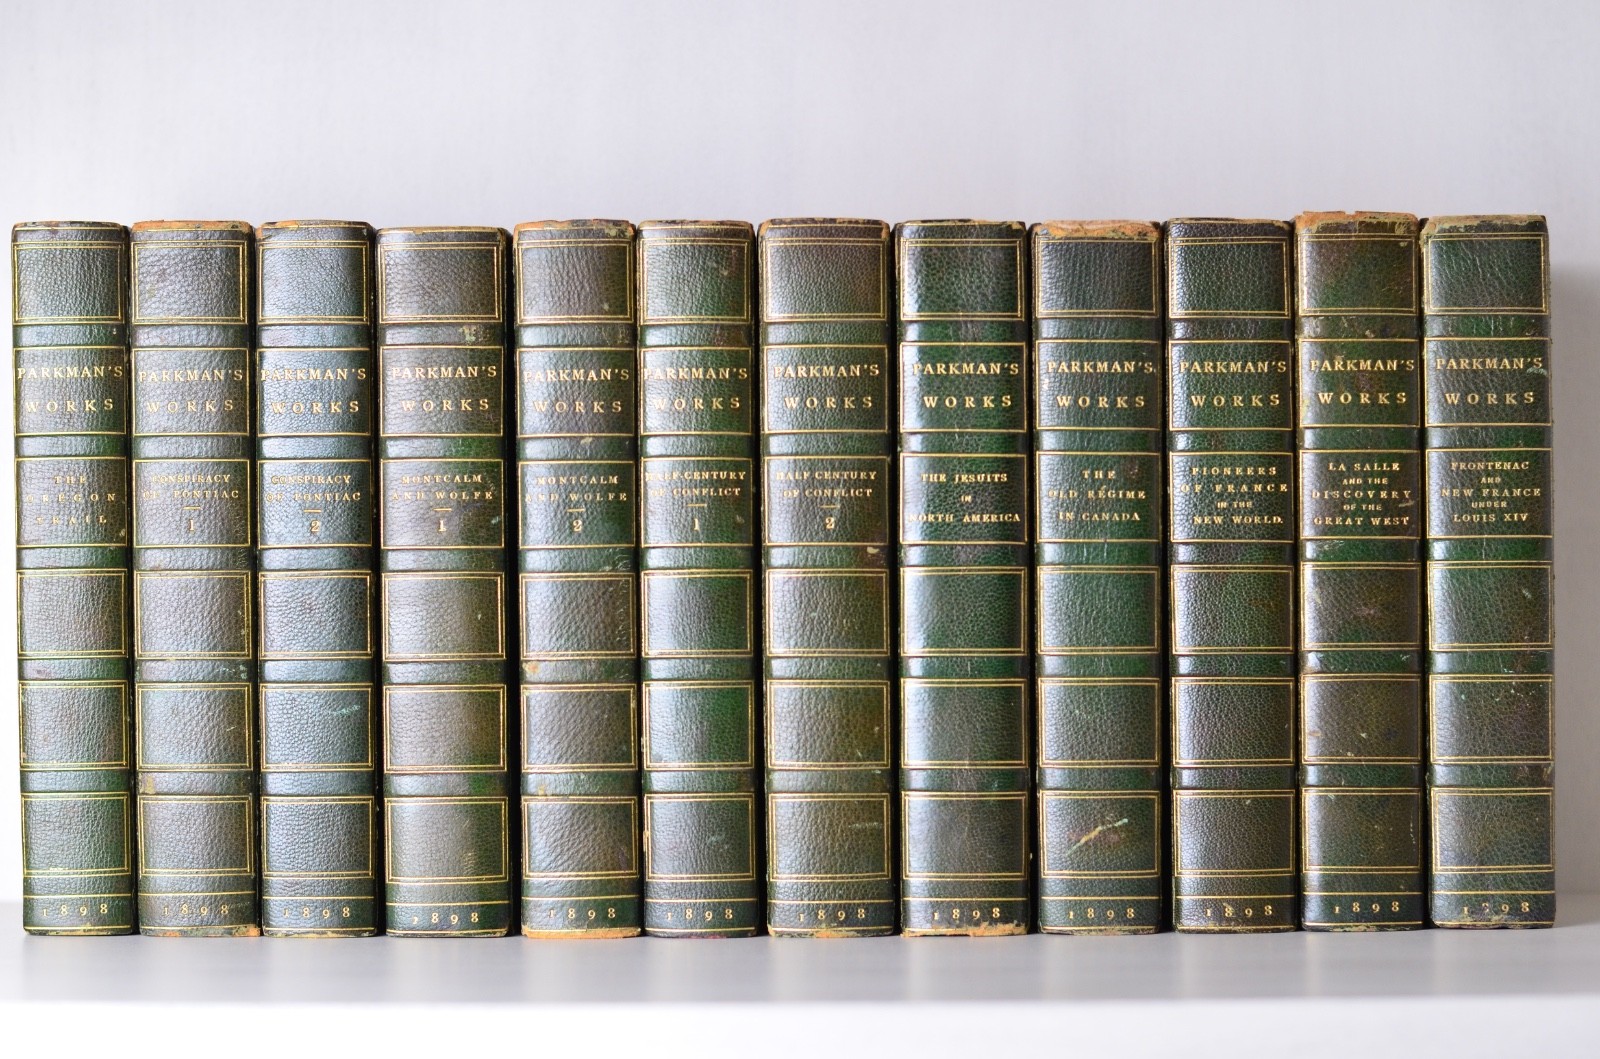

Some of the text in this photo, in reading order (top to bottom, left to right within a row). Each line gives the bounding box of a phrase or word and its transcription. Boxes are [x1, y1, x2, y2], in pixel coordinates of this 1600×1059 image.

[784, 397, 872, 409] WORKS
[924, 396, 1011, 408] WORKS
[1057, 396, 1145, 408] WORKS
[1192, 394, 1280, 407] WORKS
[1318, 393, 1407, 404] WORKS
[1445, 392, 1534, 405] WORKS
[25, 399, 113, 413] WORKS
[147, 400, 233, 413] WORKS
[272, 401, 359, 414] WORKS
[402, 399, 489, 413] WORKS
[534, 401, 622, 413] WORKS
[653, 398, 740, 410] WORKS
[1192, 466, 1276, 475] PIONEERS
[1328, 462, 1400, 471] LA SALLE
[1450, 461, 1529, 471] FRONTENAC
[54, 476, 87, 484] THE
[152, 474, 230, 483] CONSPIRACY
[272, 475, 351, 484] CONSPIRACY
[402, 474, 482, 484] MONTCALM
[537, 475, 618, 484] MONTCALM
[921, 473, 1007, 483] THE JESUITS
[1082, 471, 1116, 479] THE
[1342, 477, 1388, 485] AND THE
[650, 487, 741, 497] OF CONFLICT
[782, 488, 873, 498] OF CONFLICT
[1180, 483, 1288, 493] OF FRANCE
[1482, 489, 1541, 497] FRANCE
[26, 493, 116, 502] OREGON
[144, 490, 239, 500] OF PONTIAC
[267, 492, 361, 502] OF PONTIAC
[392, 491, 493, 500] AND WOLFE
[525, 492, 627, 503] AND WOLFE
[1048, 490, 1078, 499] OLD
[1311, 490, 1412, 499] DISCOVERY
[1233, 501, 1252, 509] THE
[1362, 503, 1382, 511] THE
[36, 515, 107, 525] TRAIL
[909, 512, 1020, 523] NORTH AMERICA
[1059, 512, 1140, 521] IN CANADA
[1193, 515, 1224, 525] NEW
[1314, 516, 1410, 526] GREAT WEST
[1454, 513, 1528, 523] LOUIS XIV
[310, 520, 319, 532] 2
[573, 520, 582, 533] 2
[825, 517, 835, 529] 2
[43, 903, 108, 917] 1898
[164, 904, 229, 916] 1898
[1206, 905, 1272, 917] 1898
[1334, 901, 1399, 913] 1898
[284, 907, 350, 919] 1898
[549, 908, 616, 921] 1898
[667, 908, 733, 921] 1898
[799, 908, 865, 922] 1898
[933, 907, 1001, 922] 1898
[1069, 907, 1135, 920] 1898
[411, 912, 479, 925] 1898
